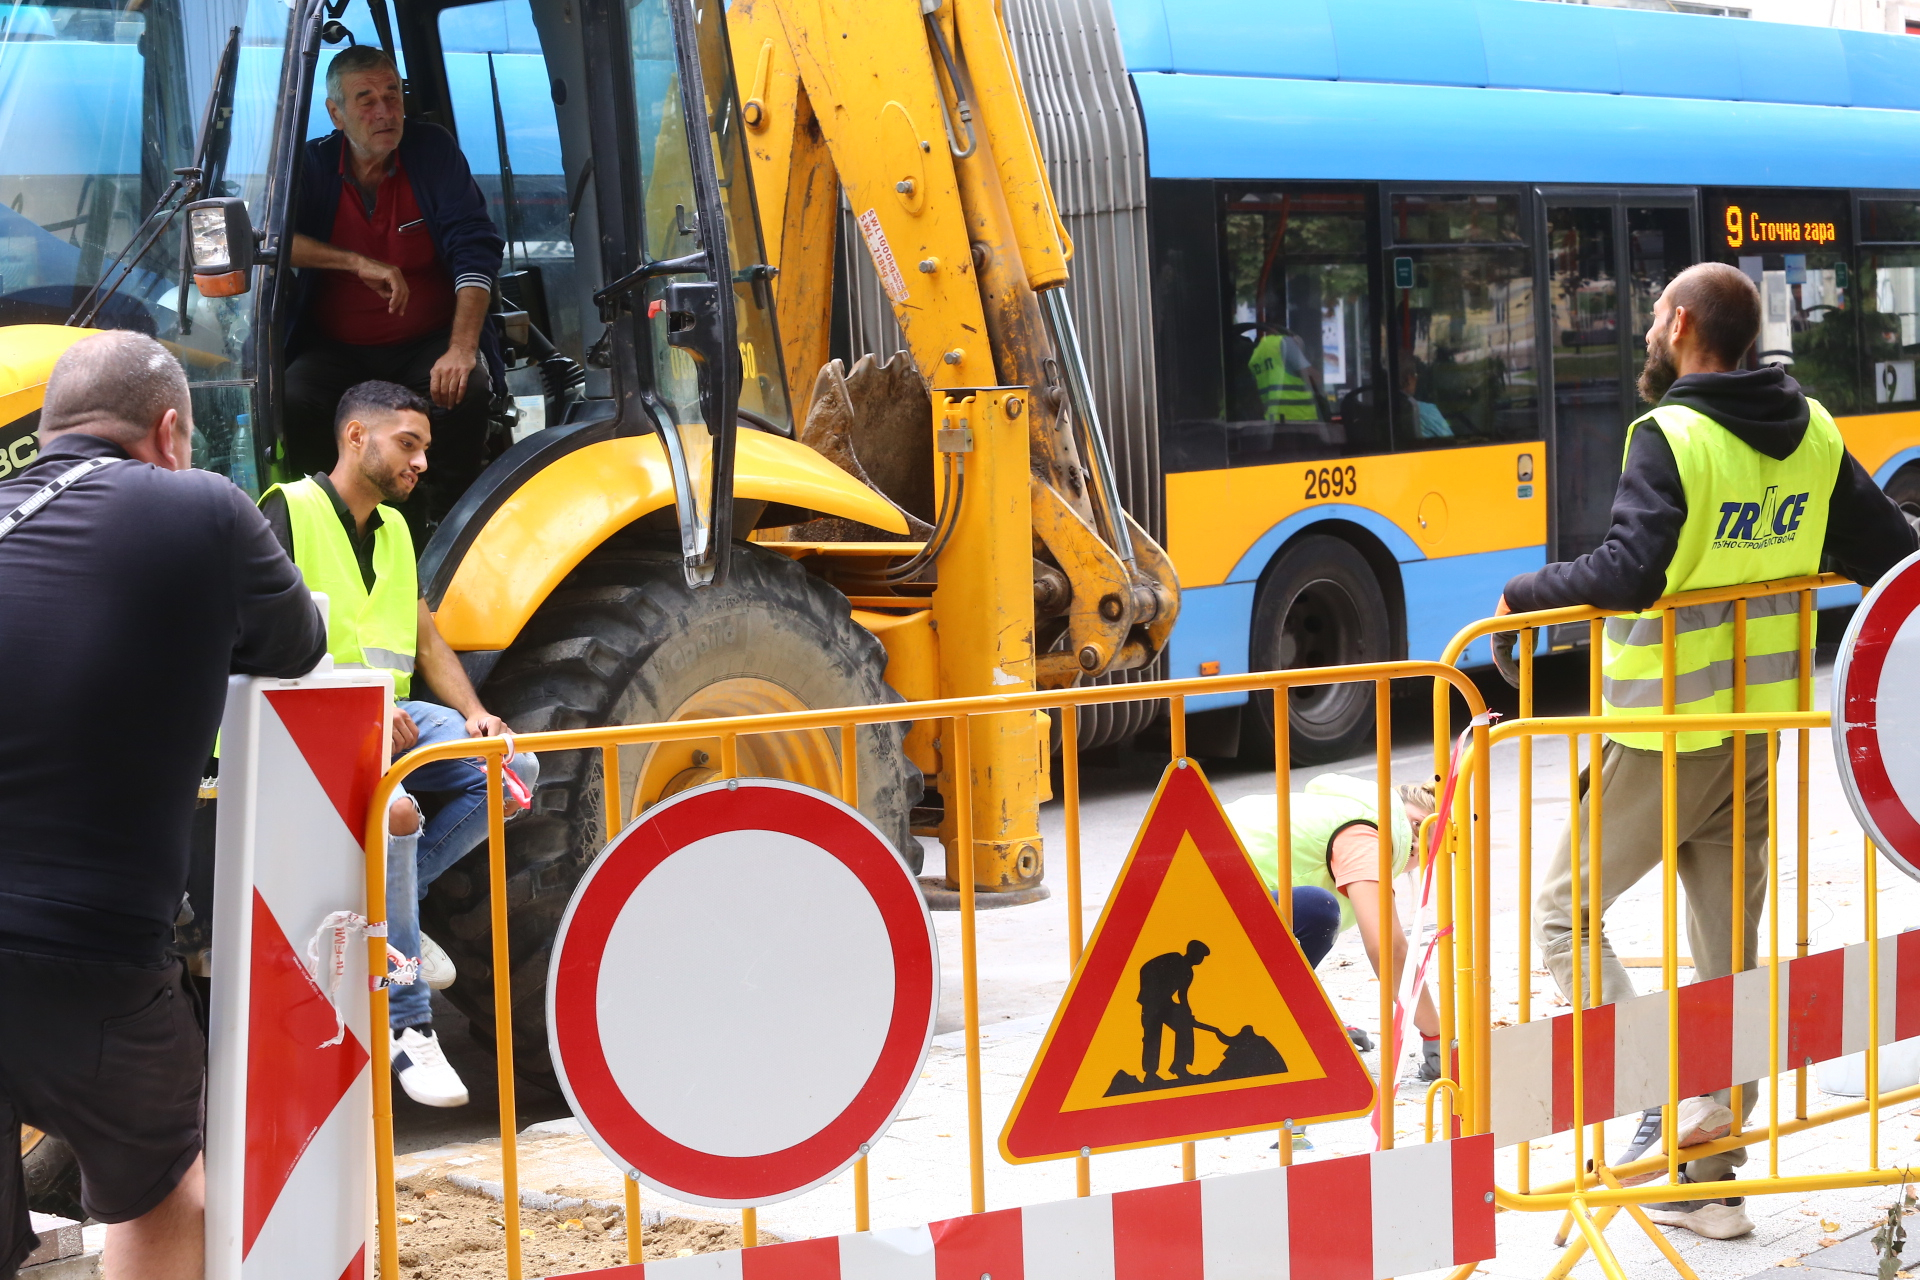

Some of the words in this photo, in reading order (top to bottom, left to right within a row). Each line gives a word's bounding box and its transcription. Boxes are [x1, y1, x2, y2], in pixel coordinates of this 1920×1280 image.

[1726, 205, 1743, 248] 9
[1751, 212, 1800, 241] Сточна
[1804, 222, 1835, 244] гара
[873, 247, 889, 278] 718kg
[877, 234, 896, 273] 1000kg
[1882, 364, 1898, 401] 9
[1305, 465, 1357, 499] 2693
[1714, 485, 1810, 540] TRACE
